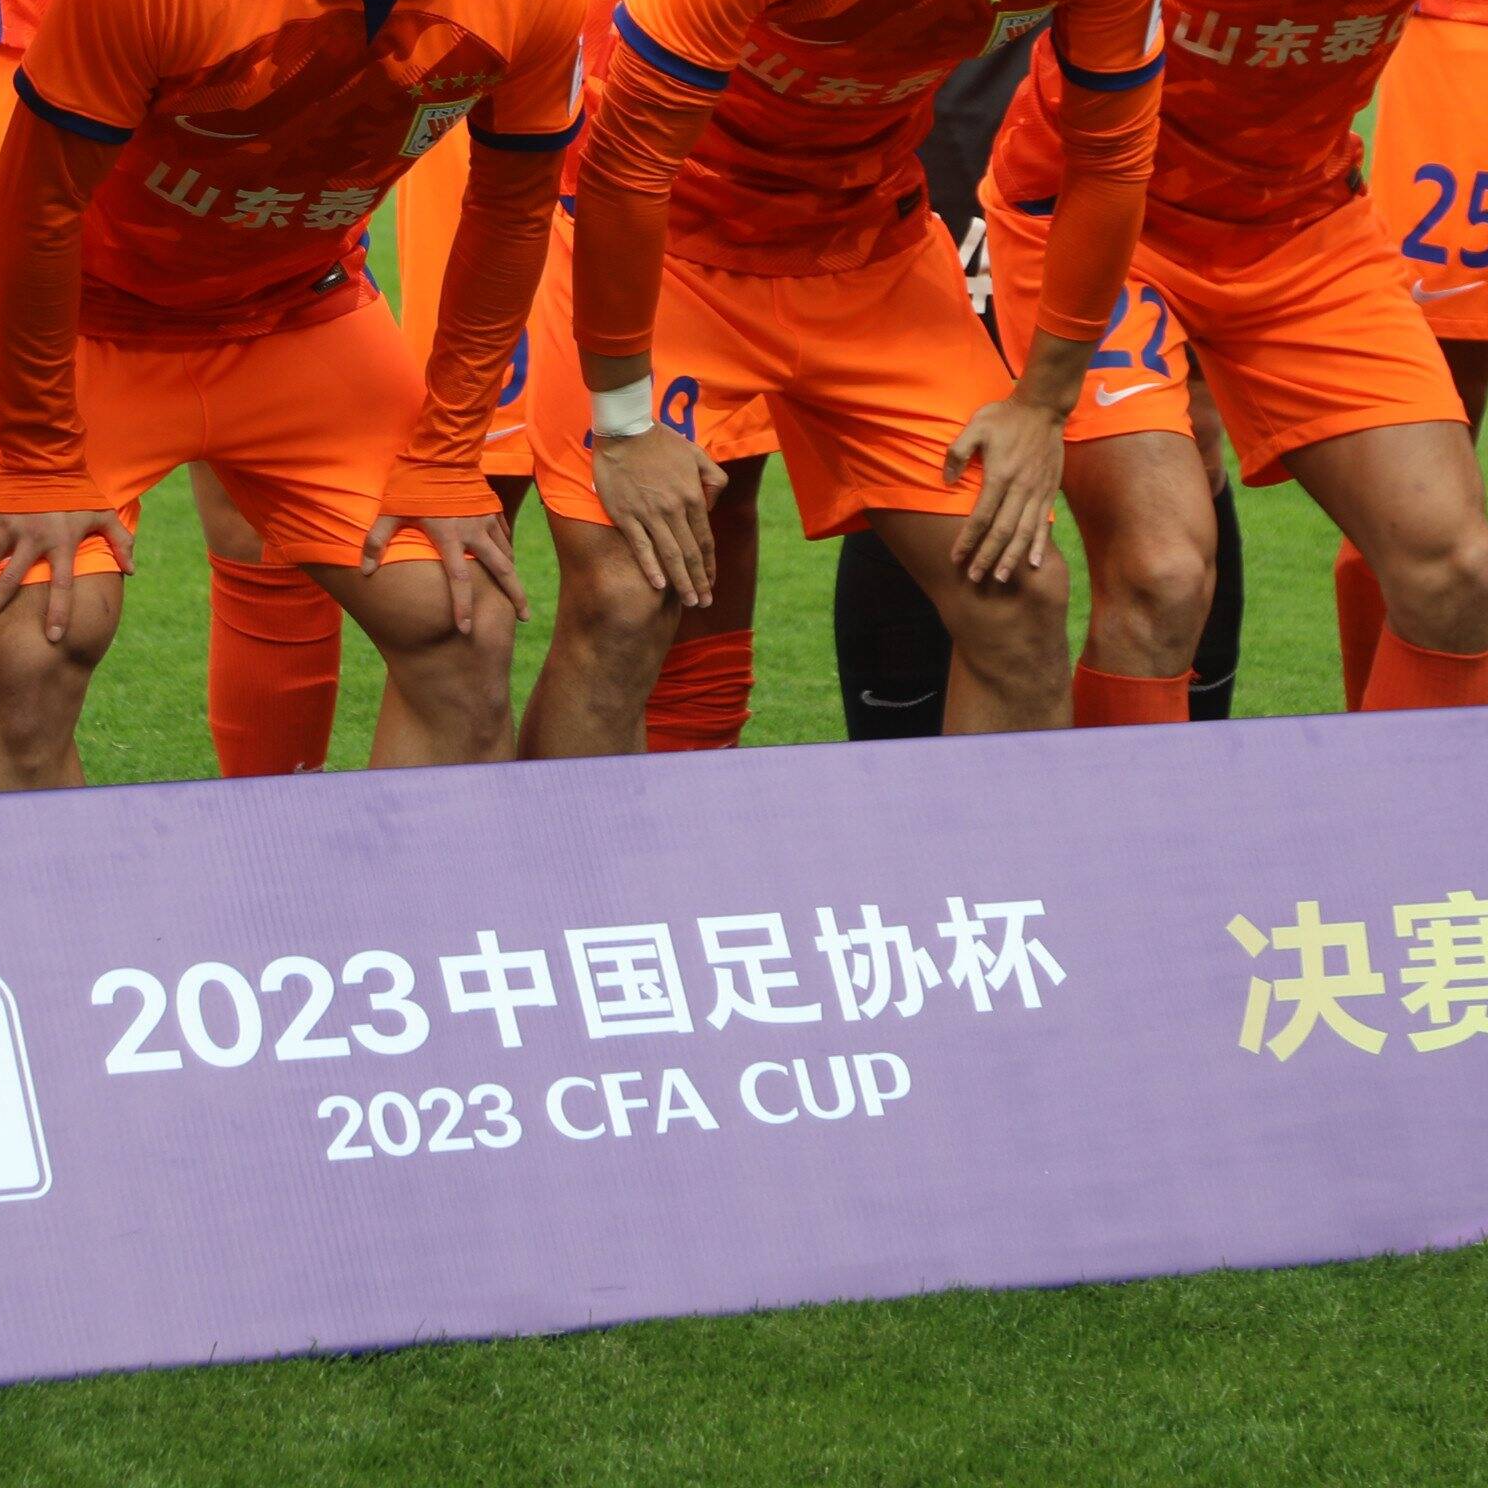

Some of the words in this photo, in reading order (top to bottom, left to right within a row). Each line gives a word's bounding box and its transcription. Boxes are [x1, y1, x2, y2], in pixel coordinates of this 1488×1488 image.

[90, 896, 1069, 1074] 2023中国足协杯
[315, 1082, 524, 1162] 2023
[544, 1067, 720, 1141] CFA
[738, 1051, 912, 1126] CUP
